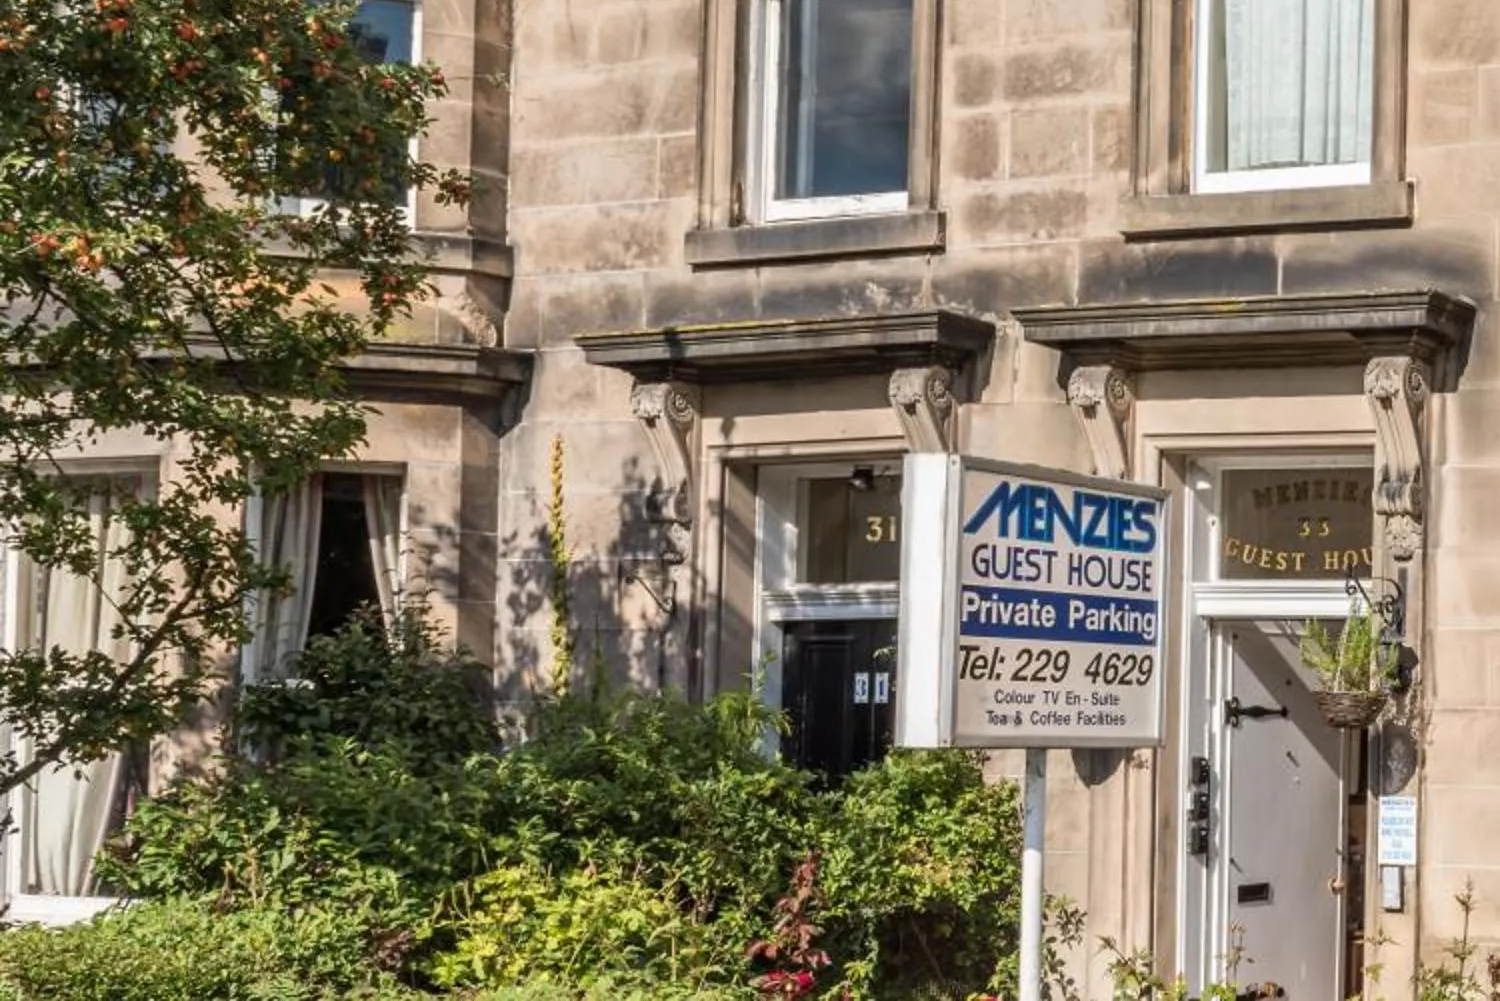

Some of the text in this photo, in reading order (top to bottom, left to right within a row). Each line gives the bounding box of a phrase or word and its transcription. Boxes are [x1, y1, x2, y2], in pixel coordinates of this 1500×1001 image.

[865, 516, 896, 542] 31
[963, 481, 1156, 552] MENZIES
[972, 544, 1152, 592] GUEST HOUSE
[1224, 538, 1372, 571] GUEST HOU
[962, 592, 1157, 639] Private Parking
[959, 646, 1153, 686] Tel: 229 4629
[994, 690, 1036, 705] Colour
[1043, 691, 1060, 705] TV
[986, 711, 1126, 727] Tea & Coffee Facilities
